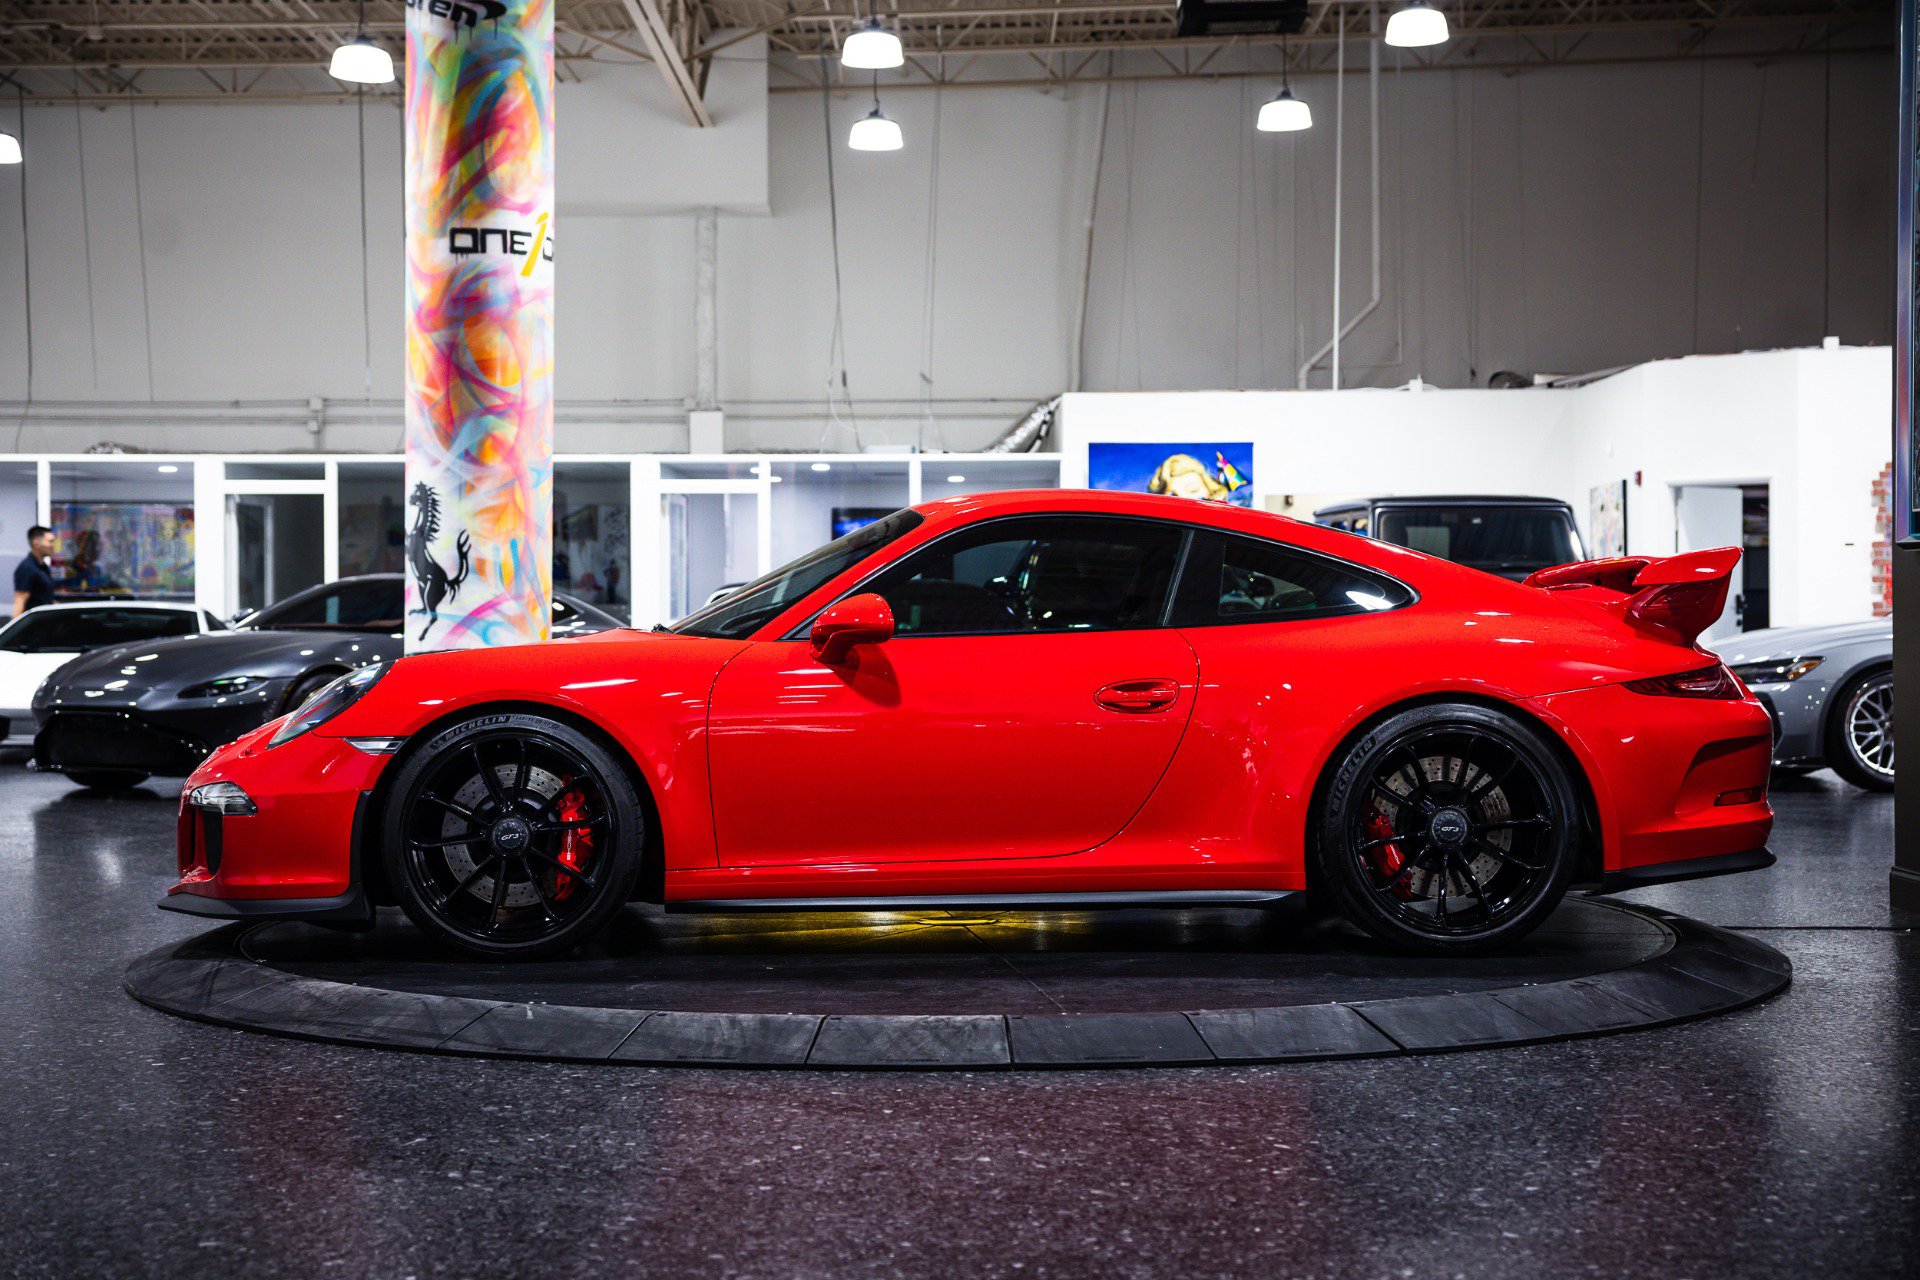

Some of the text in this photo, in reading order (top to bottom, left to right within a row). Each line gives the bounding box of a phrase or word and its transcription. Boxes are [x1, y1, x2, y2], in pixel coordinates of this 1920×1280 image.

[444, 715, 507, 740] MICHELIN
[1331, 739, 1373, 812] MICHELIN
[501, 833, 519, 841] GT3
